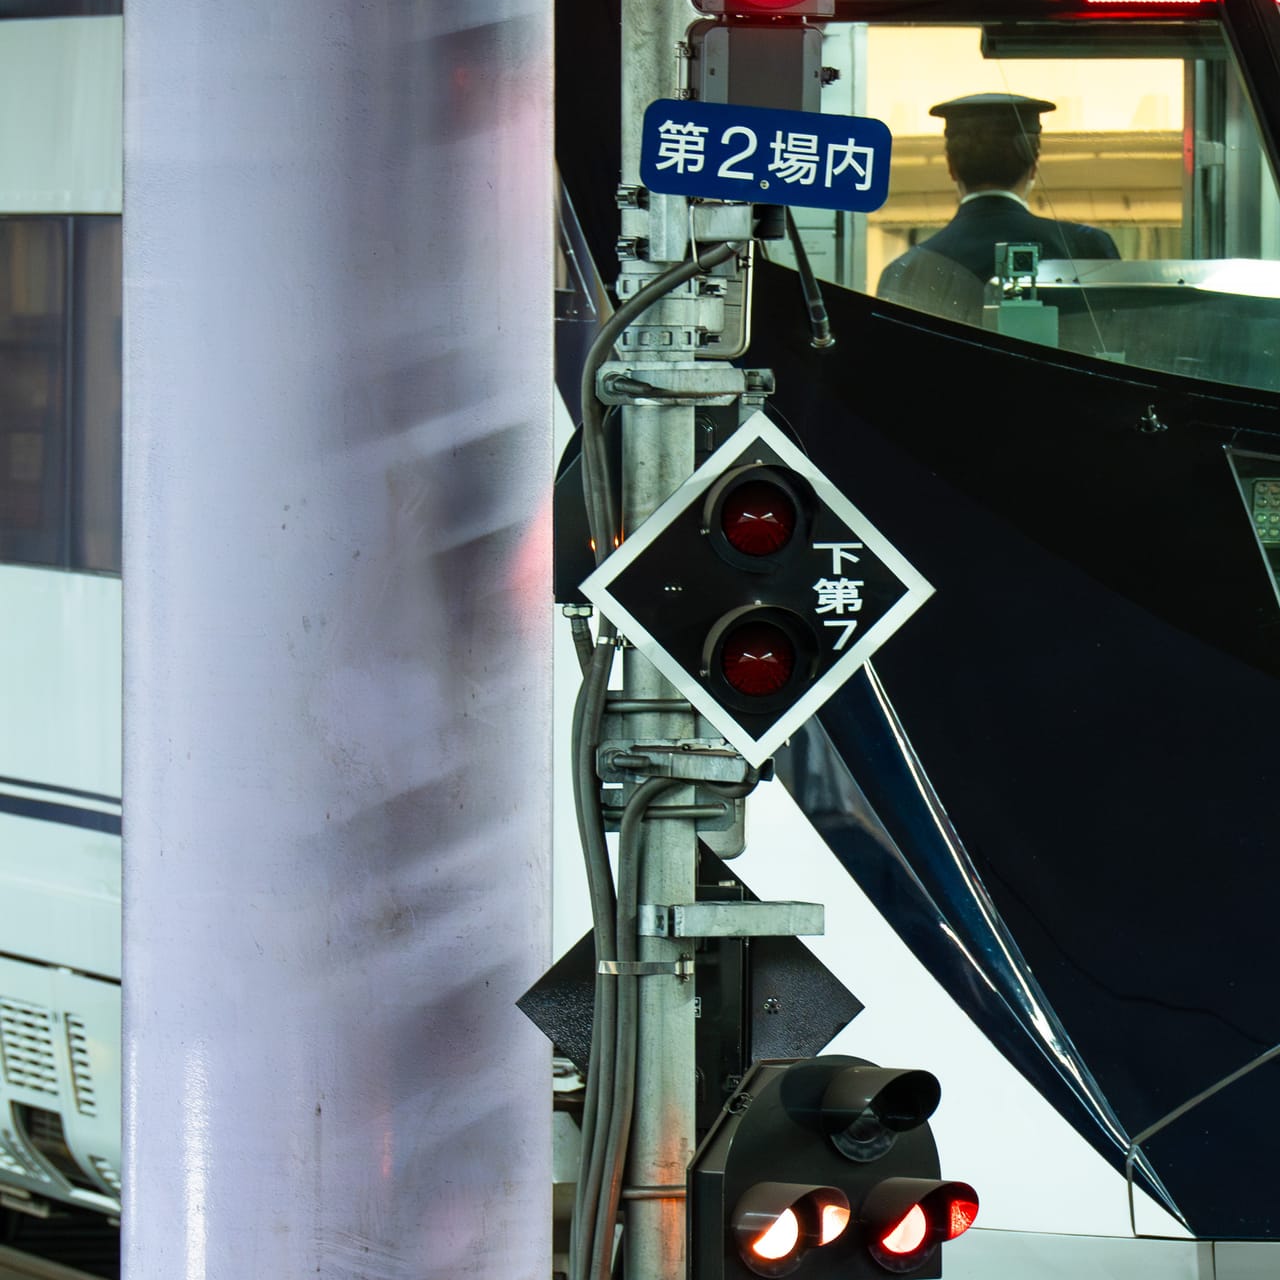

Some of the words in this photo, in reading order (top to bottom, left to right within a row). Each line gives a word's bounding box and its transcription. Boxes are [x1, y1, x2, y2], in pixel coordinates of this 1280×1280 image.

[655, 119, 875, 192] 第2場内
[812, 542, 864, 651] 下第7
